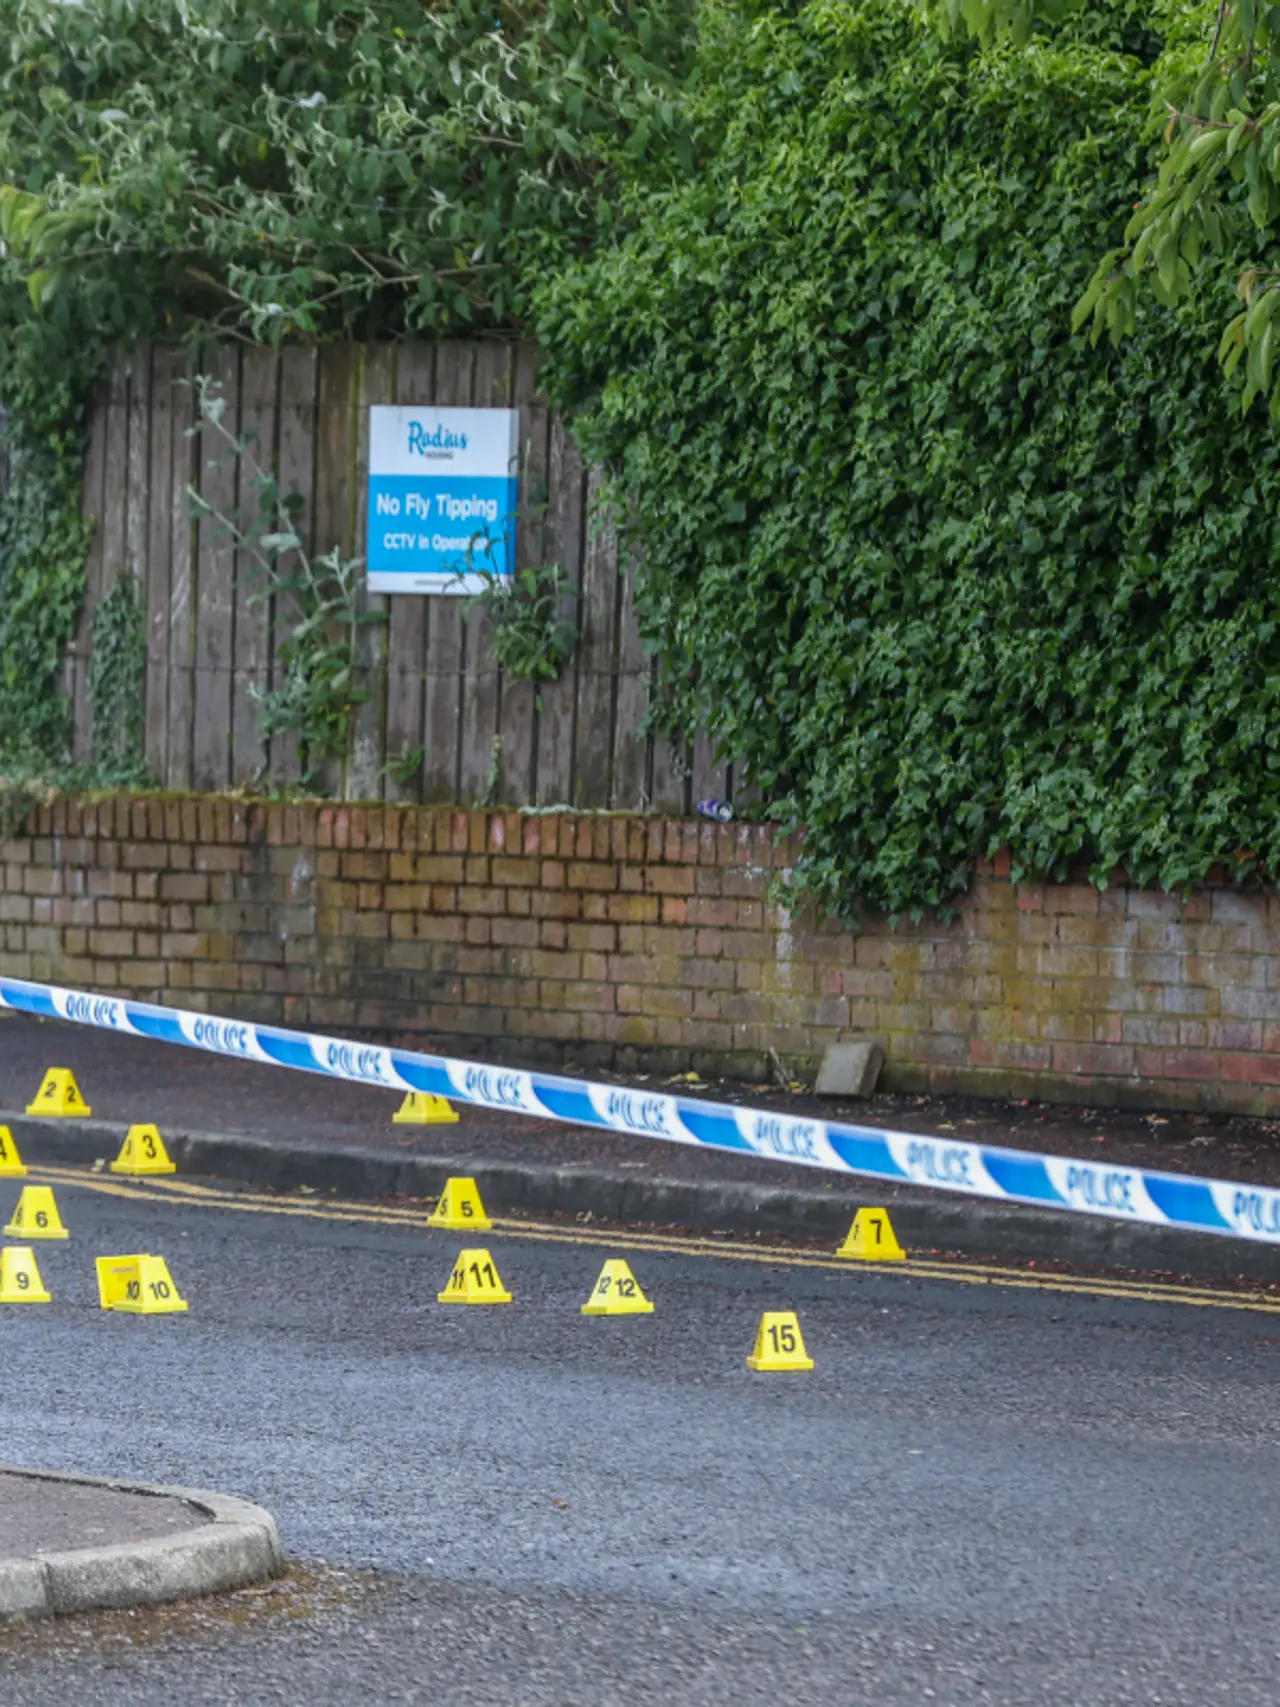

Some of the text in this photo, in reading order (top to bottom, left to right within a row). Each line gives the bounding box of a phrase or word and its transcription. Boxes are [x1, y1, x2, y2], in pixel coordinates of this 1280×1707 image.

[408, 420, 469, 456] Radius
[376, 493, 499, 522] No Fly Tipping
[384, 532, 489, 552] CCTV in Operaton
[44, 1082, 57, 1098] 2
[67, 1086, 76, 1103] 2
[66, 995, 118, 1026] POLICE
[194, 1021, 247, 1052] POLICE
[328, 1043, 385, 1079] POLICE
[907, 1141, 974, 1186] POLICE
[1067, 1166, 1136, 1212] POLICE
[143, 1134, 157, 1159] 3
[461, 1201, 474, 1217] 5
[36, 1211, 49, 1228] 6
[870, 1219, 882, 1244] 7
[17, 1271, 30, 1289] 9
[452, 1269, 465, 1290] 11
[470, 1261, 497, 1288] 11
[127, 1280, 140, 1299] 10
[149, 1280, 170, 1299] 10
[615, 1278, 636, 1297] 12
[768, 1324, 796, 1353] 15
